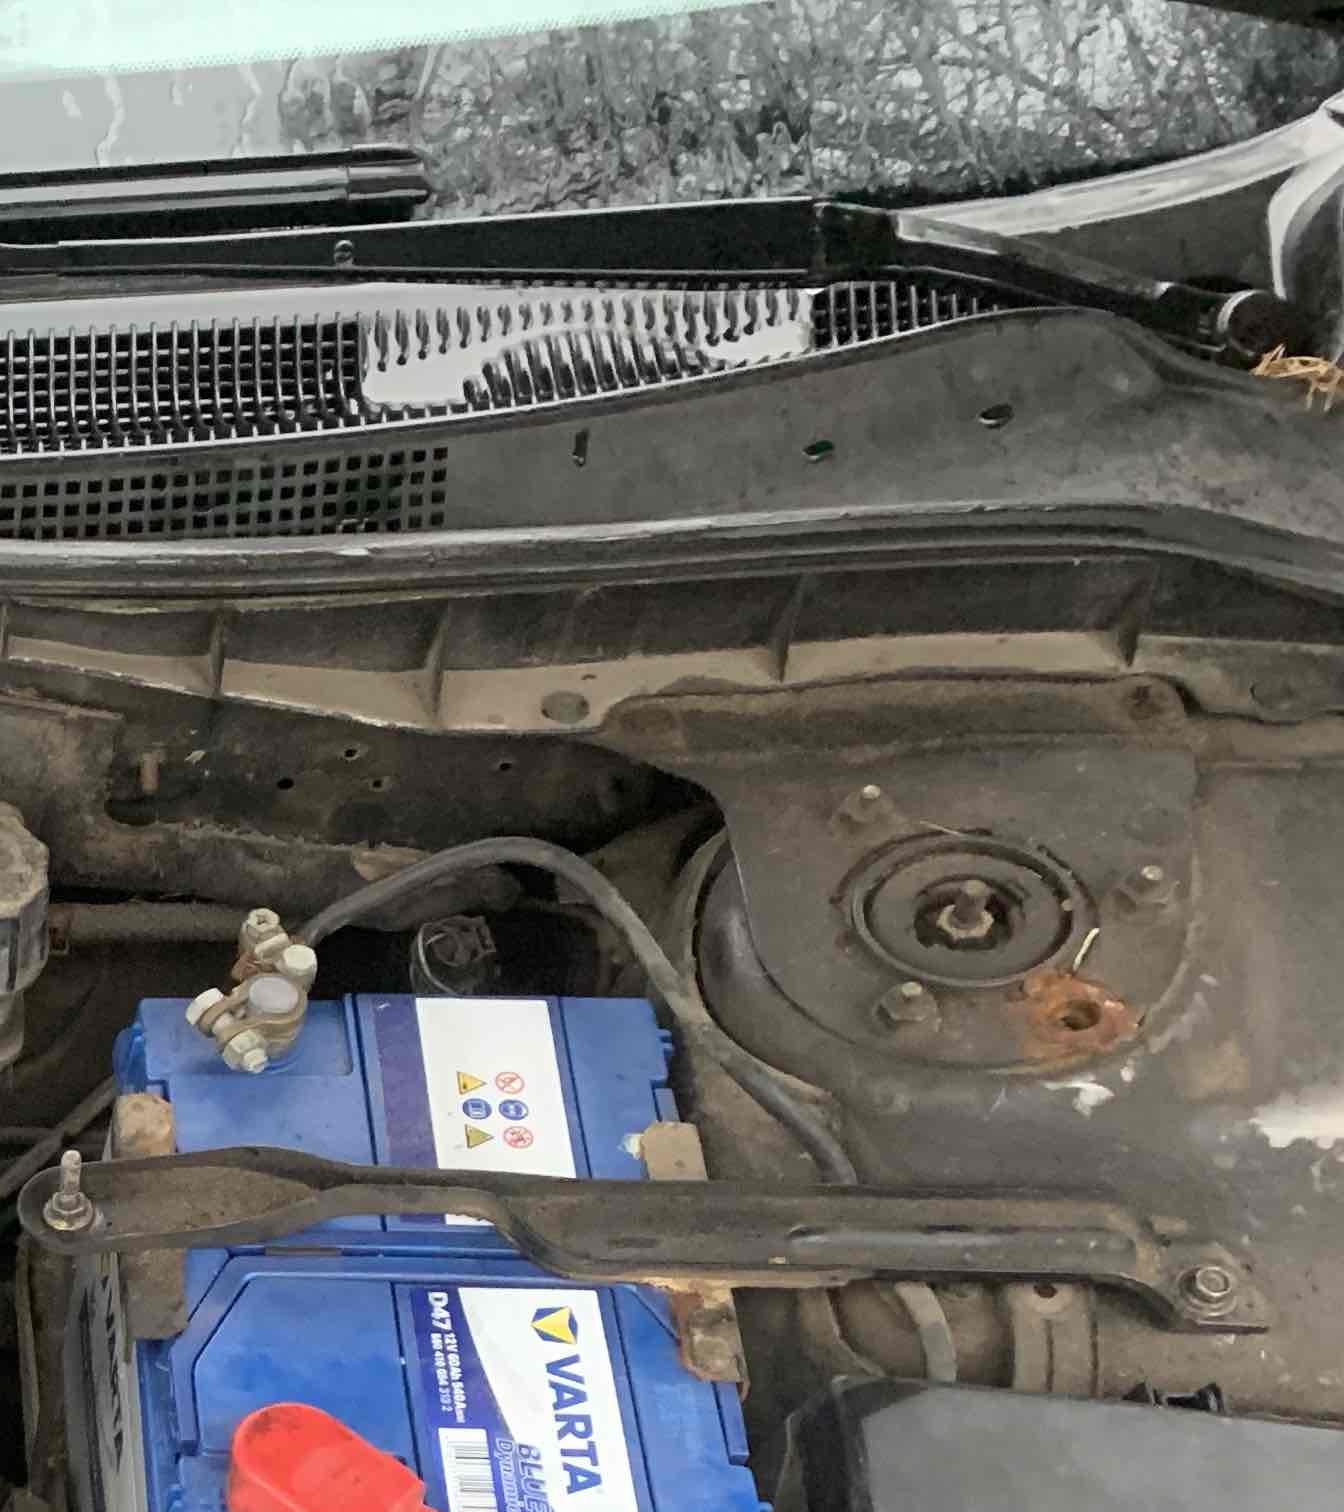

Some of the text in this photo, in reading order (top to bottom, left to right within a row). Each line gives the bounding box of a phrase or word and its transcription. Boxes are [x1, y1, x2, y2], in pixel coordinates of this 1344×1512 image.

[427, 1290, 452, 1331] D47
[444, 1331, 459, 1353] 12V
[545, 1353, 603, 1495] VARTA
